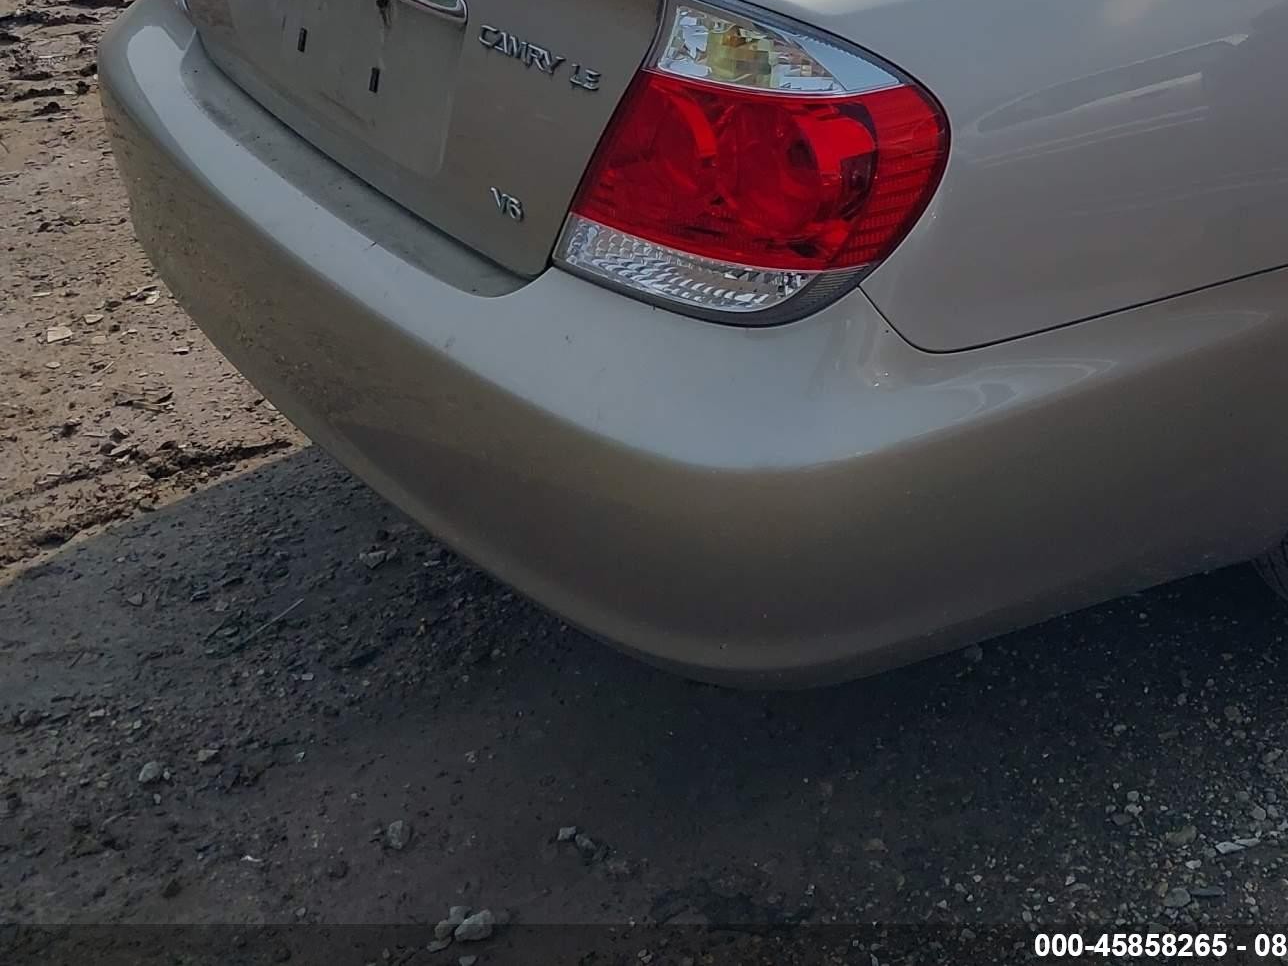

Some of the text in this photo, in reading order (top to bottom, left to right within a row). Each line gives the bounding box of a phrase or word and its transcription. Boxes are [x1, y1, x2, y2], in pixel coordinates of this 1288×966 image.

[479, 24, 601, 91] CAMRY LE
[490, 186, 524, 222] V6
